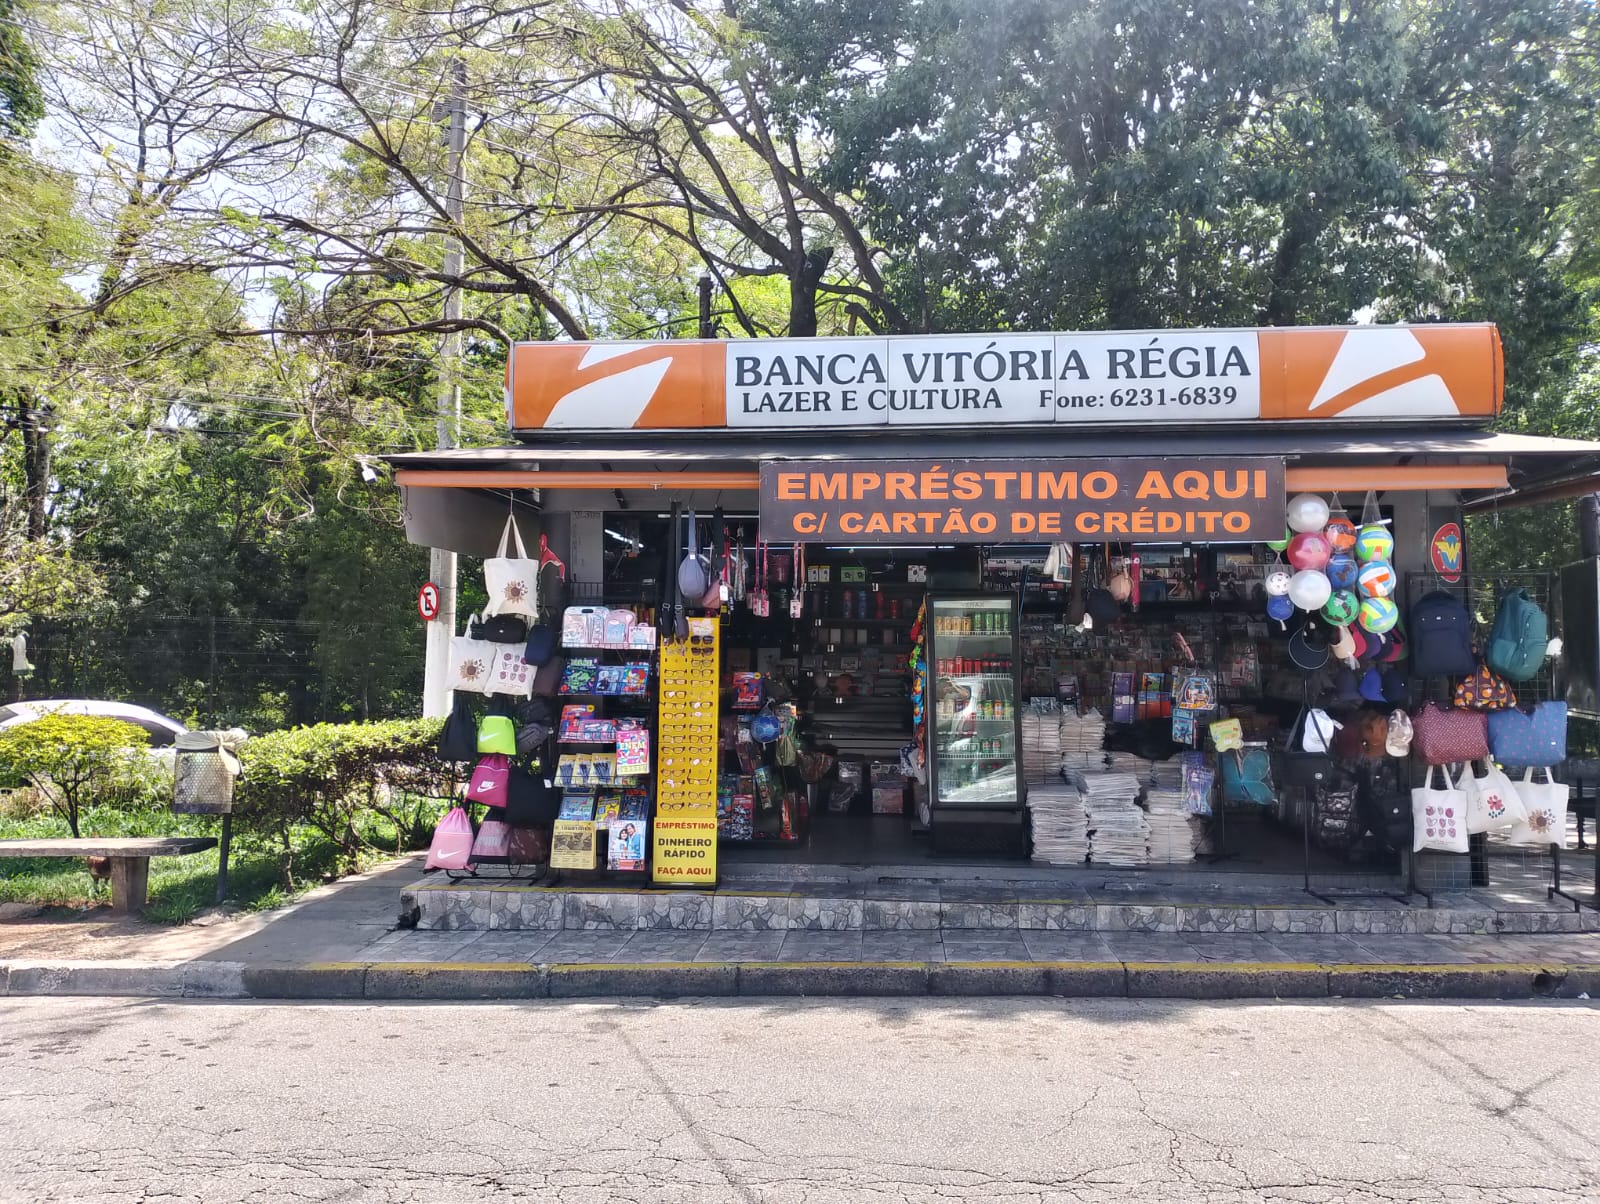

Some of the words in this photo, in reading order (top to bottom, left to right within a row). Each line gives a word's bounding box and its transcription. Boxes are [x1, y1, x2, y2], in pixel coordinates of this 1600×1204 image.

[735, 354, 886, 387] BANCA
[903, 341, 1090, 384] VITÓRIA
[1107, 338, 1251, 380] RÉGIA
[743, 391, 832, 413] LAZER
[841, 391, 858, 411] E
[867, 388, 1003, 411] CULTURA
[1110, 386, 1238, 407] 6231-6839
[777, 466, 1118, 500] EMPRÉSTIMO
[1135, 469, 1267, 501] AQUI
[792, 511, 828, 534] C/
[839, 508, 997, 534] CARTÃO
[1011, 511, 1062, 534] DE
[1075, 506, 1251, 534] CRÉDITO
[658, 838, 712, 847] DINHEIRO
[663, 848, 706, 859] RÁPIDO
[657, 866, 684, 876] FAÇA
[686, 867, 712, 876] AQUI
